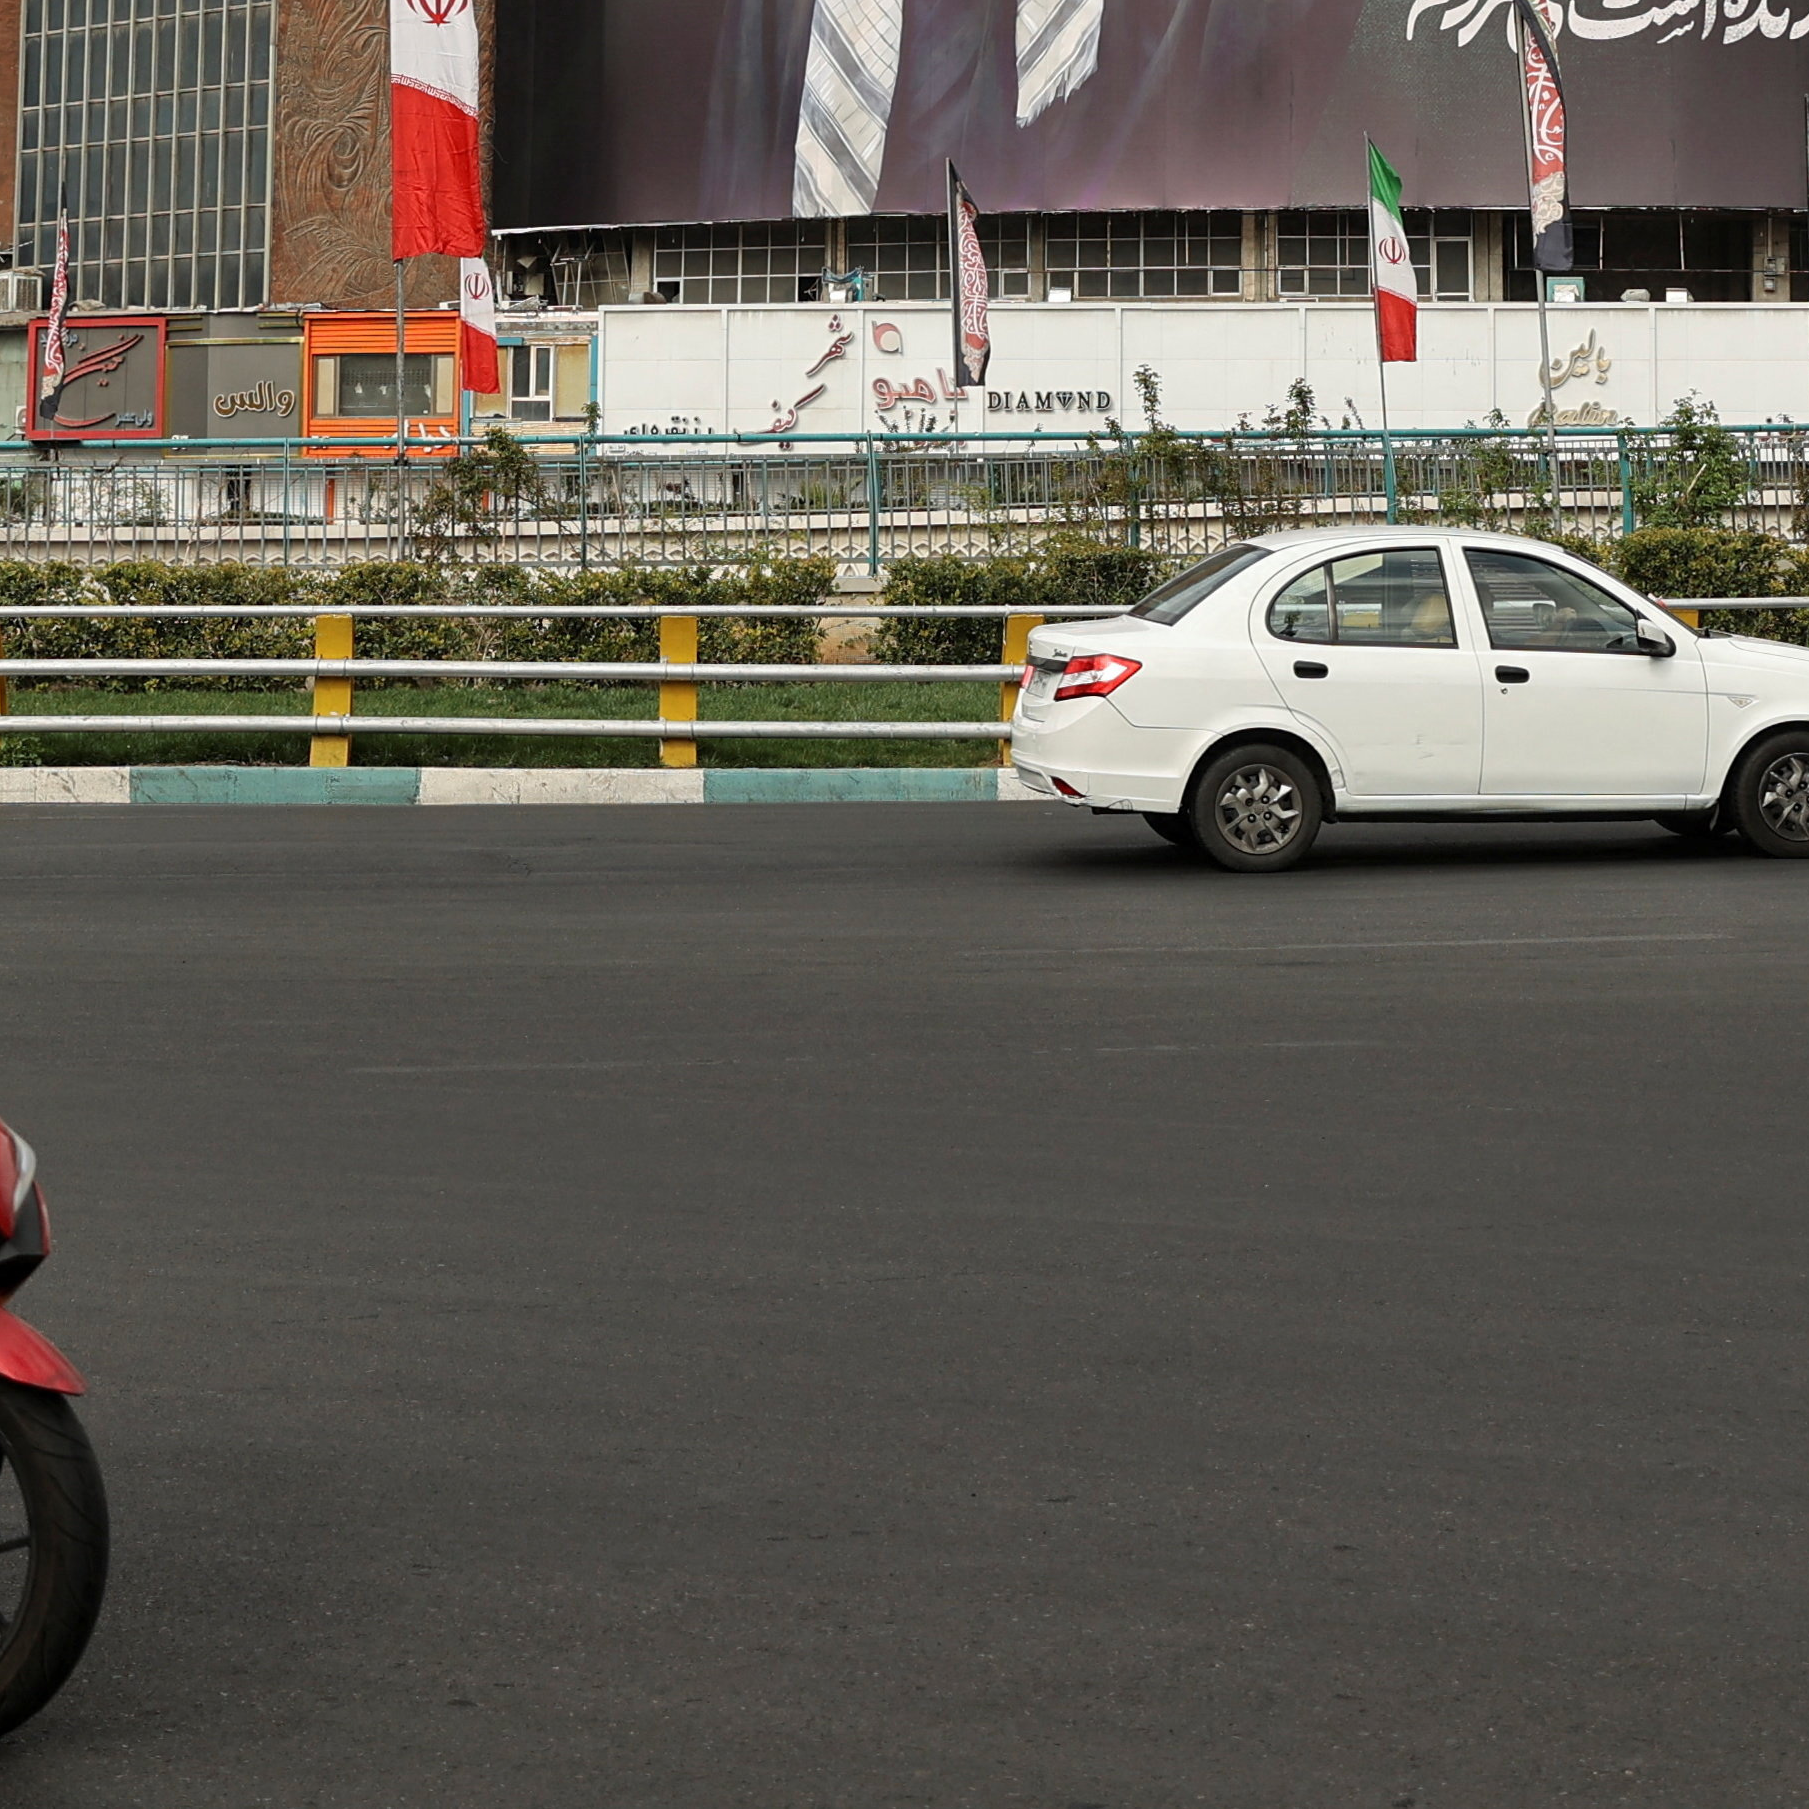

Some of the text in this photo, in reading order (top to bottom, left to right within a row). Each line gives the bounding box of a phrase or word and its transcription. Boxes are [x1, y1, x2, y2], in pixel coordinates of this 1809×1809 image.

[805, 313, 855, 378] شهر
[1538, 327, 1612, 390] بالین
[213, 379, 296, 418] والس
